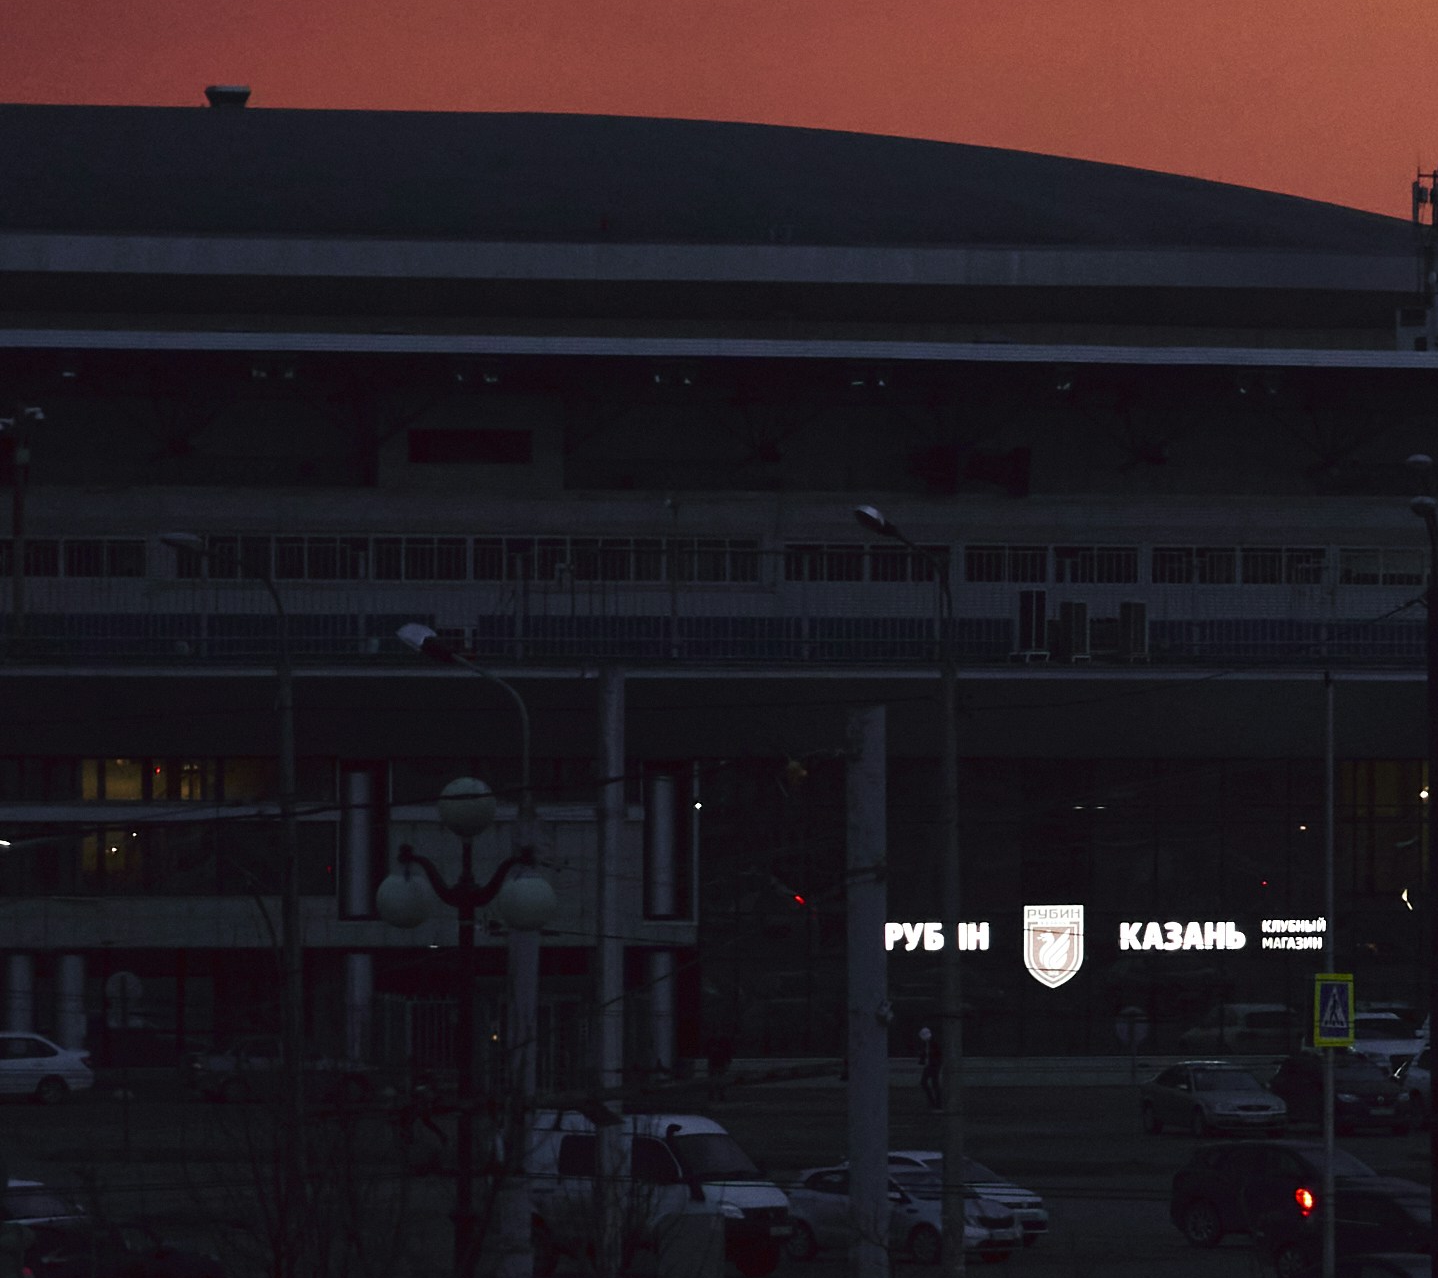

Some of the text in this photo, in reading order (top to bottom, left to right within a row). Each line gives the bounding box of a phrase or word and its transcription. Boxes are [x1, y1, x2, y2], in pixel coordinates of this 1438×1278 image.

[1027, 909, 1081, 920] РУБИН
[1261, 917, 1326, 933] КЛУБНЫЙ
[1119, 921, 1246, 951] КАЗАНЬ
[1262, 937, 1322, 950] МАГАЗИН
